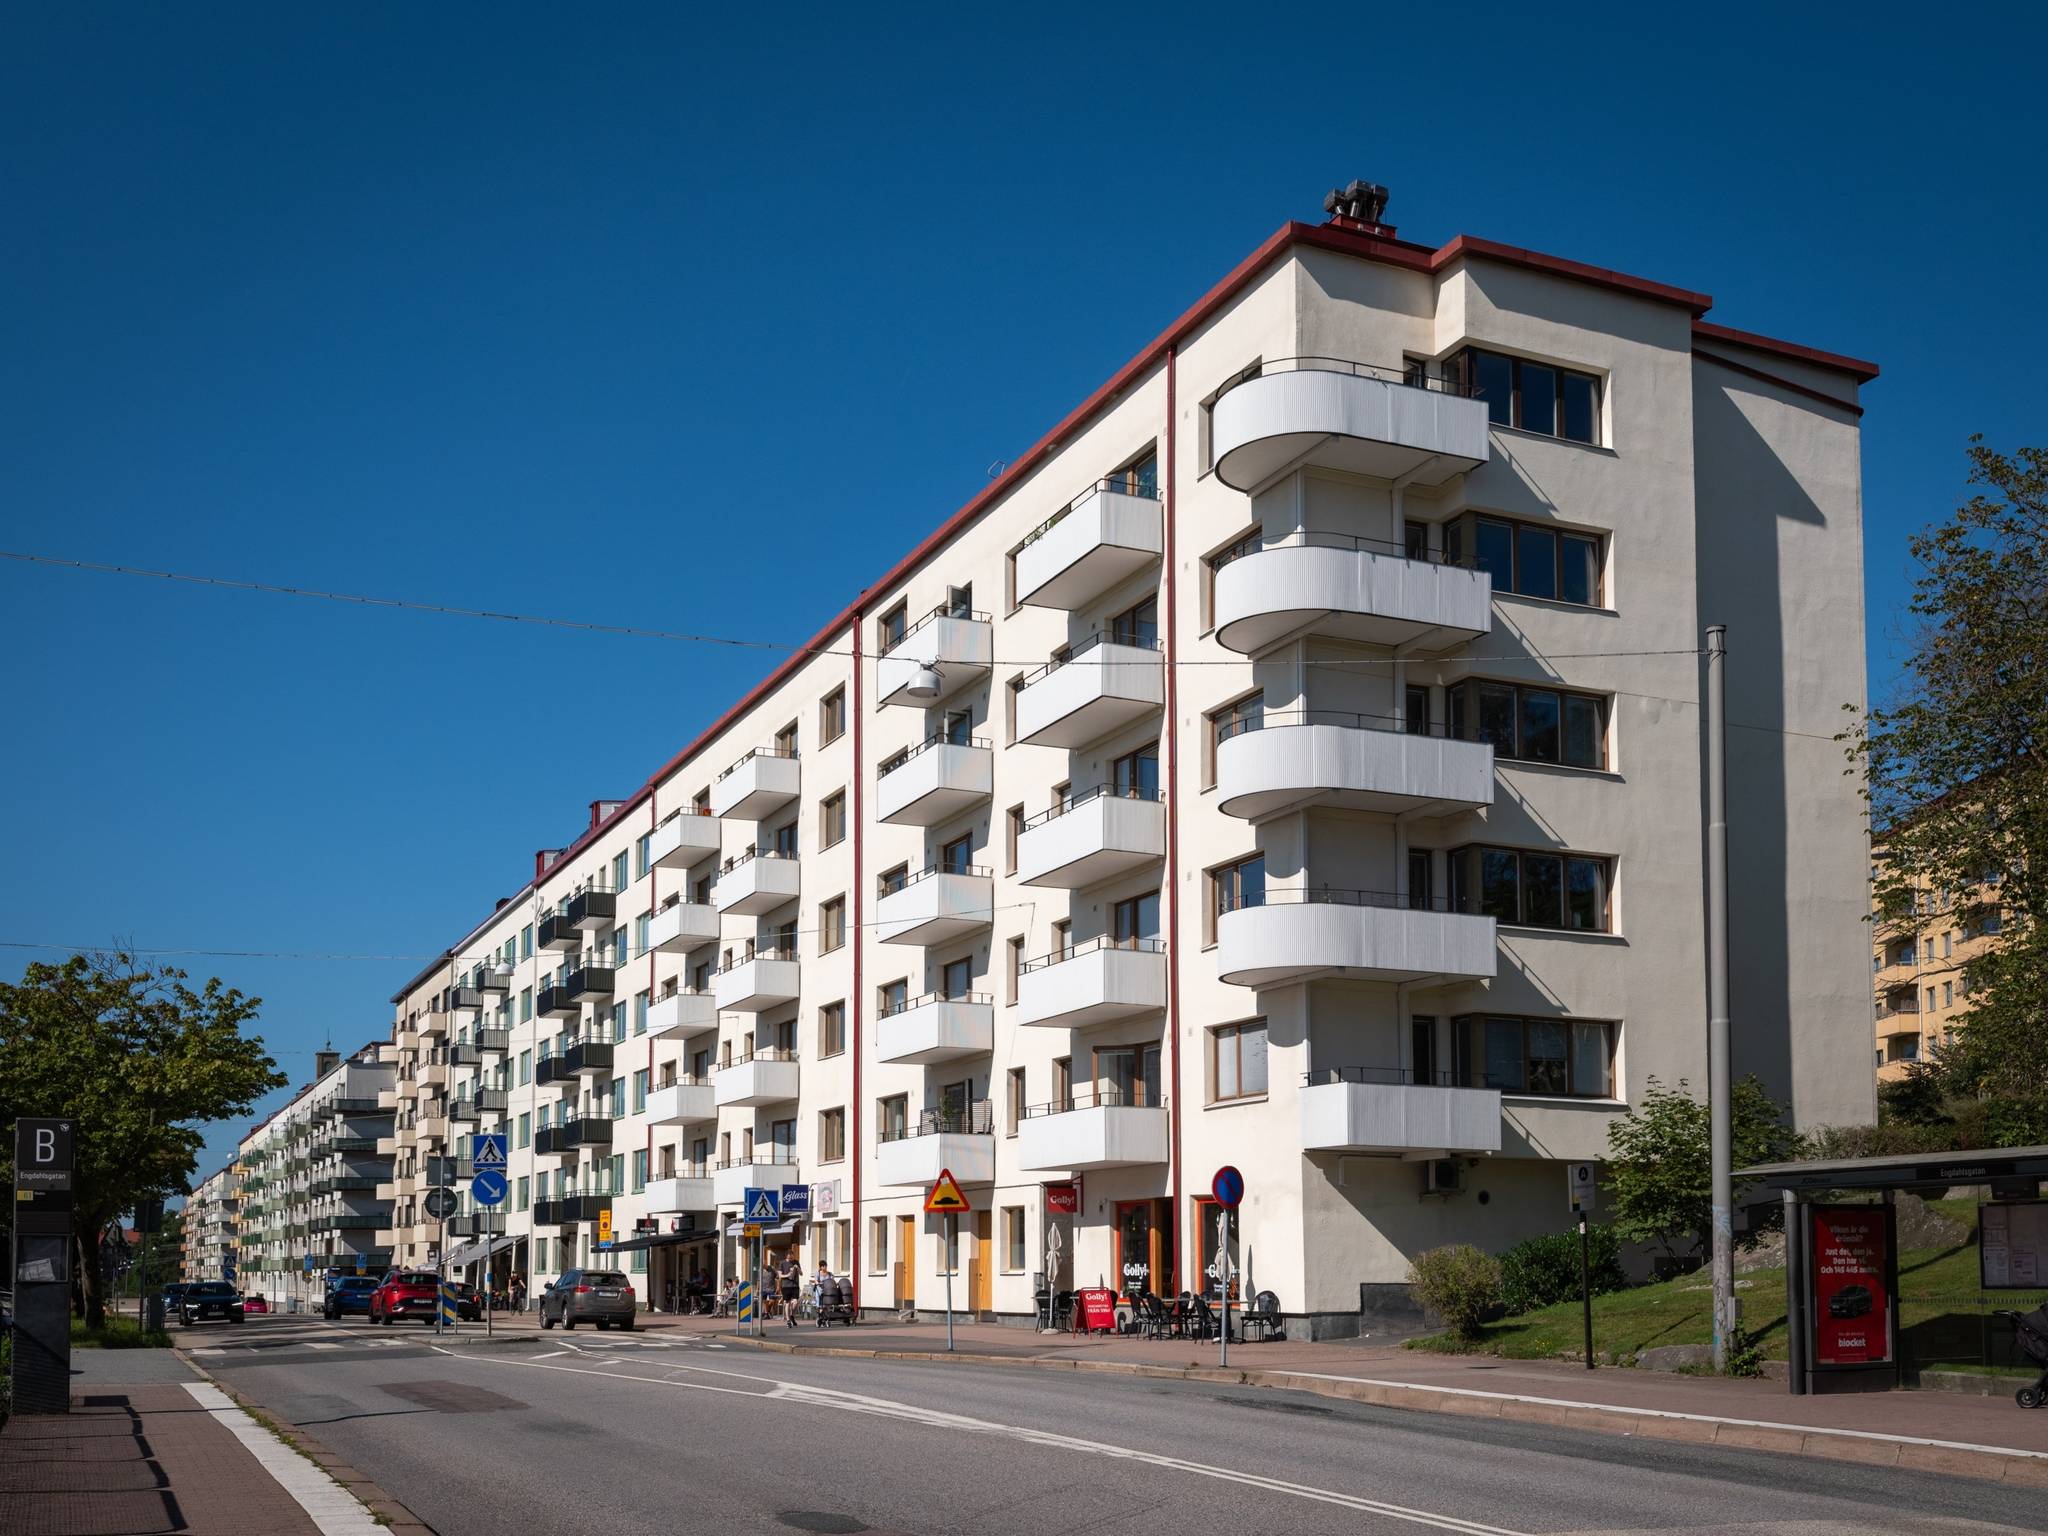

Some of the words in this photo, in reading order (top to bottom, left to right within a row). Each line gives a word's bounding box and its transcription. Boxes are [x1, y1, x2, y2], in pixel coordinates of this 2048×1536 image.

[35, 1128, 55, 1162] B
[20, 1171, 66, 1180] Engdahlsgatan
[1940, 1167, 1986, 1178] Engdahlsgatan
[783, 1190, 808, 1204] Glass
[1050, 1195, 1075, 1206] Golly!
[1123, 1263, 1147, 1280] Golly!
[1085, 1293, 1108, 1302] Golly!
[1838, 1337, 1866, 1348] blocket
